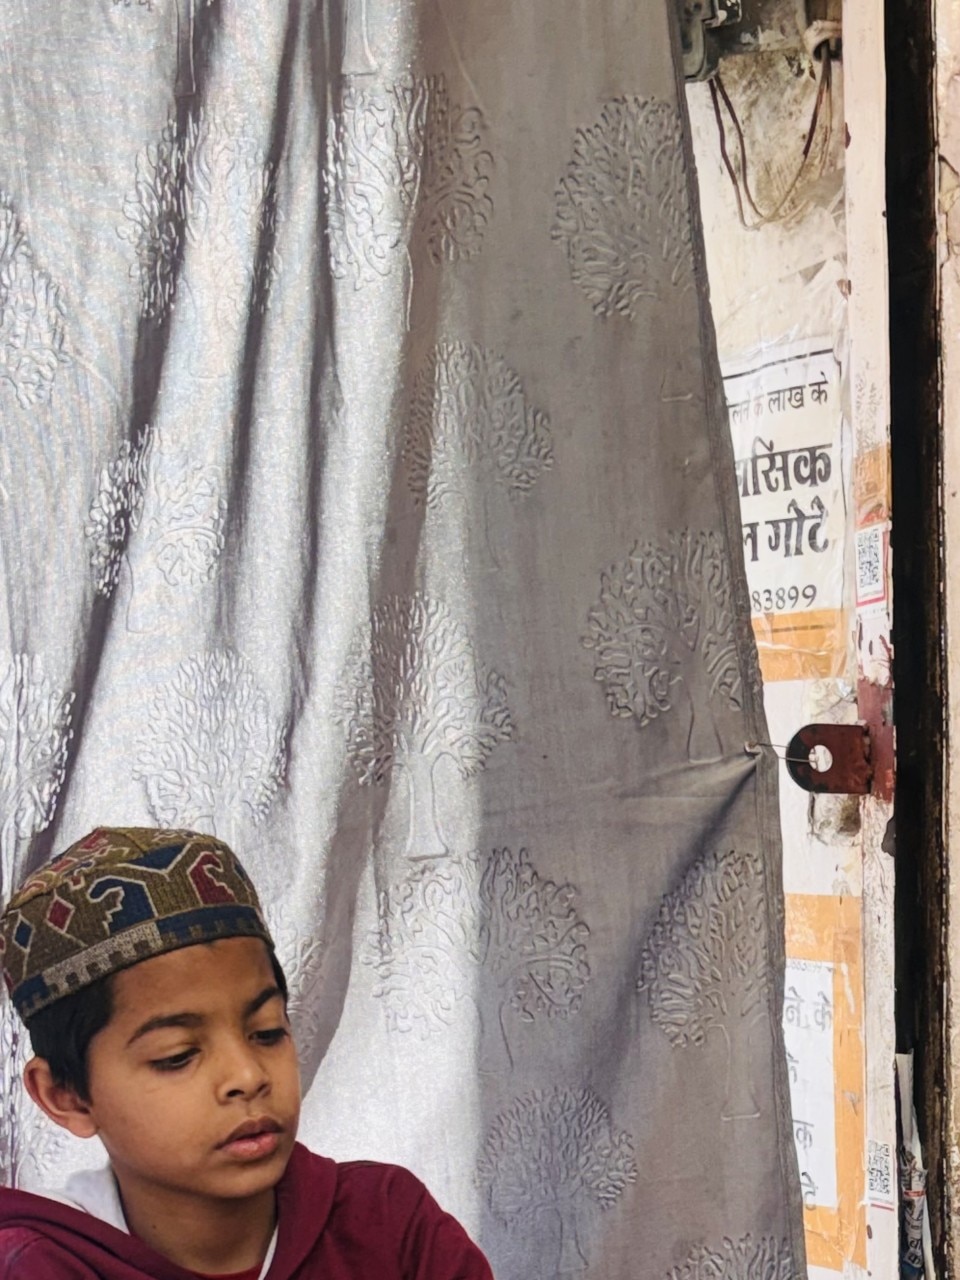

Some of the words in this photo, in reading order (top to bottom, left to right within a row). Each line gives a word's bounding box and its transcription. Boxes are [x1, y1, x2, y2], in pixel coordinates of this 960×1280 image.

[767, 385, 806, 414] लाख
[809, 371, 829, 404] के
[765, 495, 829, 556] गोटे
[752, 585, 817, 612] 83899
